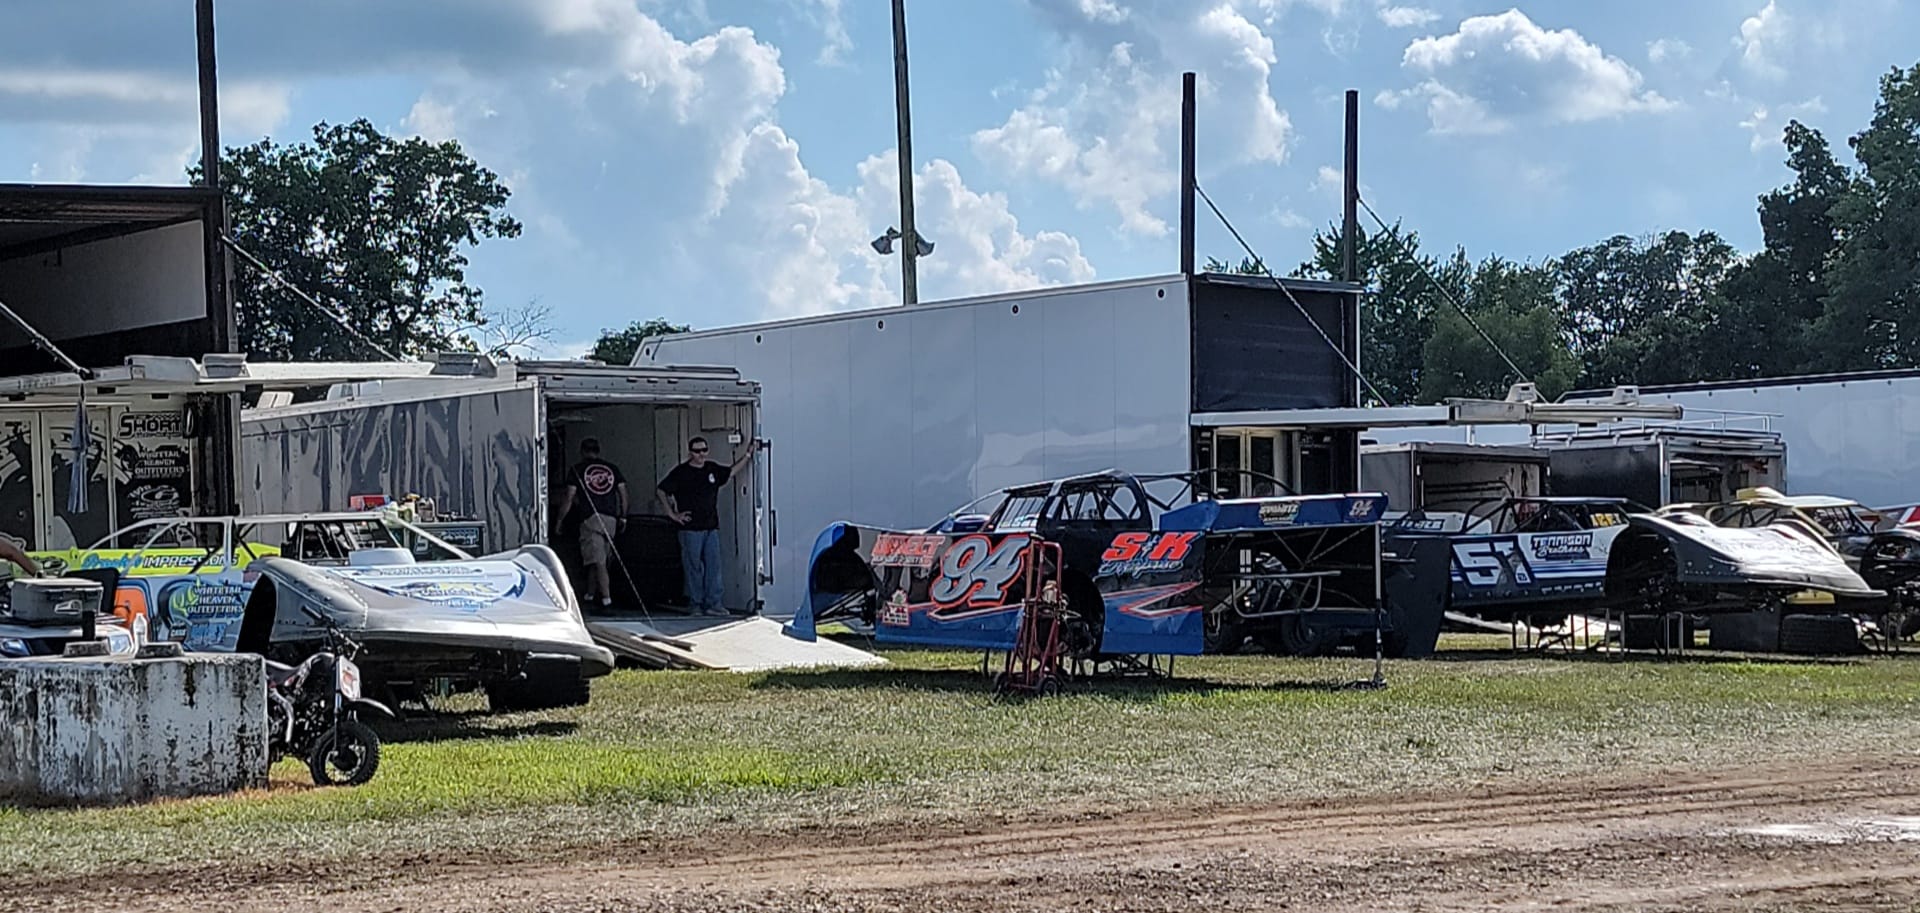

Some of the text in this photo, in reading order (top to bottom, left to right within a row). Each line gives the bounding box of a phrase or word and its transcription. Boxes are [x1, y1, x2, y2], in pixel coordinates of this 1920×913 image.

[1532, 534, 1591, 549] TENNISON
[931, 534, 1032, 607] 94
[199, 596, 236, 605] HEAVEN
